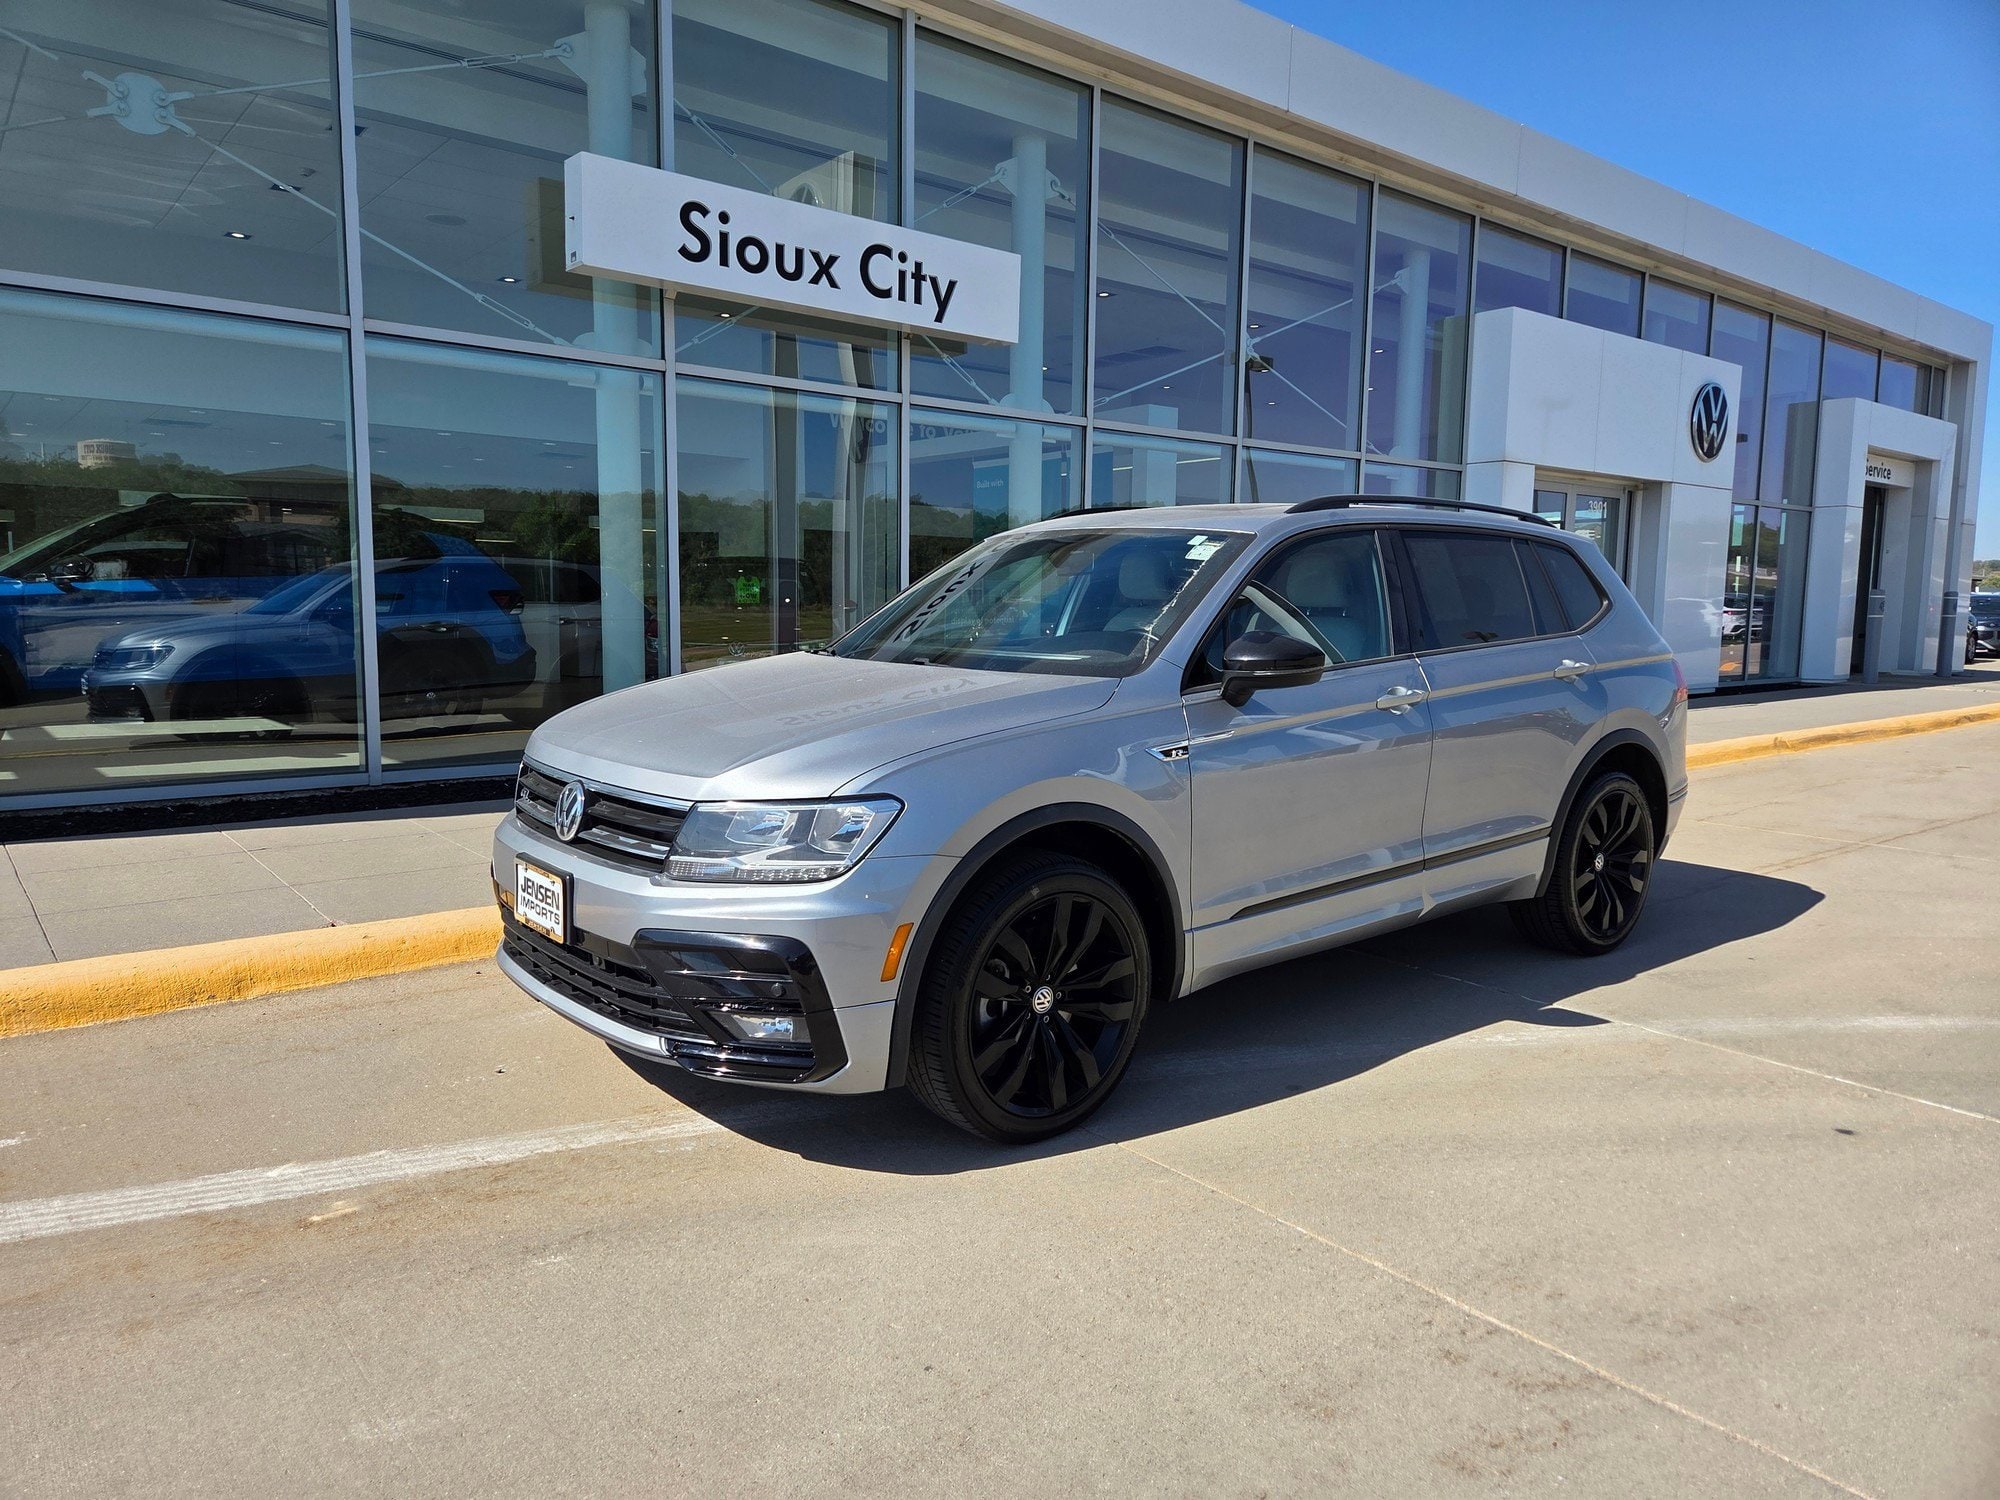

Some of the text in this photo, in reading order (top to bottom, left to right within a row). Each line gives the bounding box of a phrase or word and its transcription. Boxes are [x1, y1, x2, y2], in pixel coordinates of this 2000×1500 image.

[677, 199, 958, 323] Sioux City
[1588, 500, 1607, 514] 3901
[521, 875, 560, 911] JENSEN
[520, 895, 560, 925] IMPORTS
